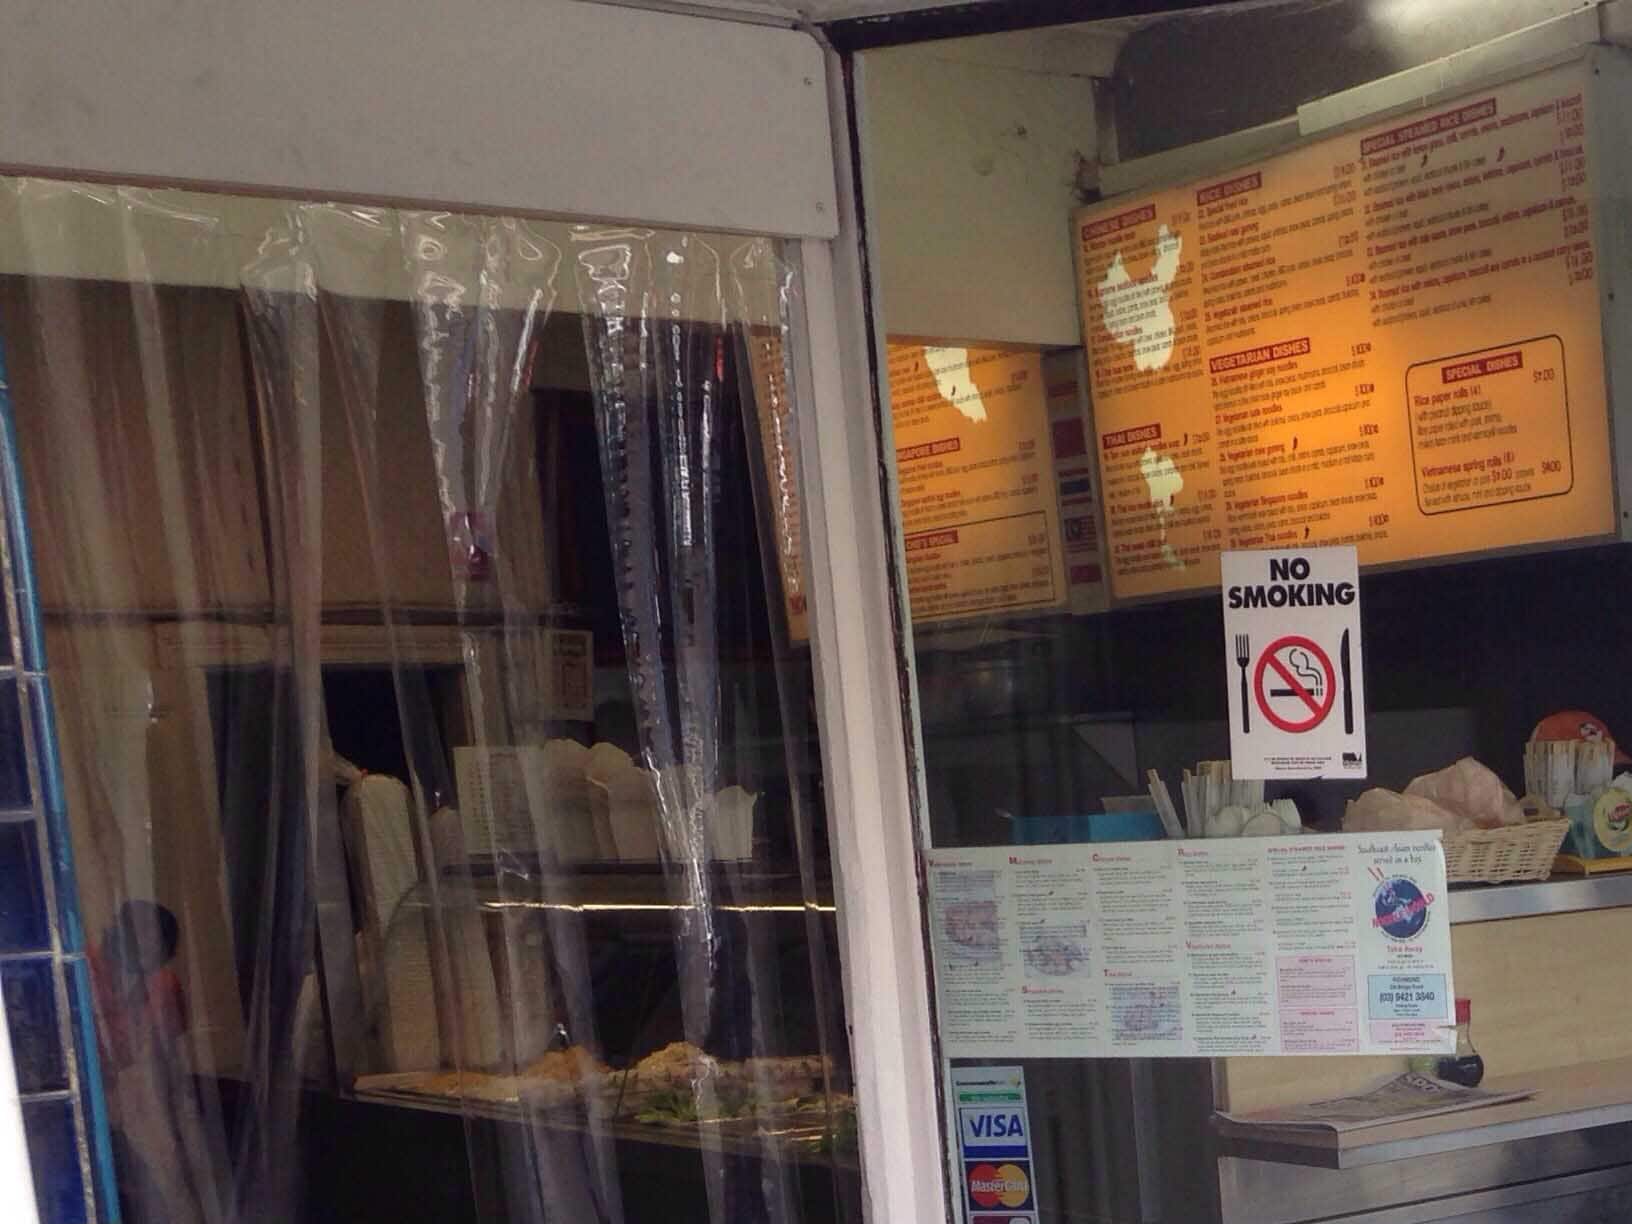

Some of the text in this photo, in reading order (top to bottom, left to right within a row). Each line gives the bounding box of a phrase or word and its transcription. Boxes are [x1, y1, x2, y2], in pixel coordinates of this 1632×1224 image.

[1210, 348, 1271, 372] VEGETARIAN
[1272, 340, 1310, 358] DISHES
[1445, 355, 1520, 382] SPECIAL DISHES
[1269, 557, 1310, 581] NO
[1228, 582, 1356, 609] SMOKING
[970, 1114, 1023, 1137] VISA
[971, 1179, 1028, 1193] MasterCard
